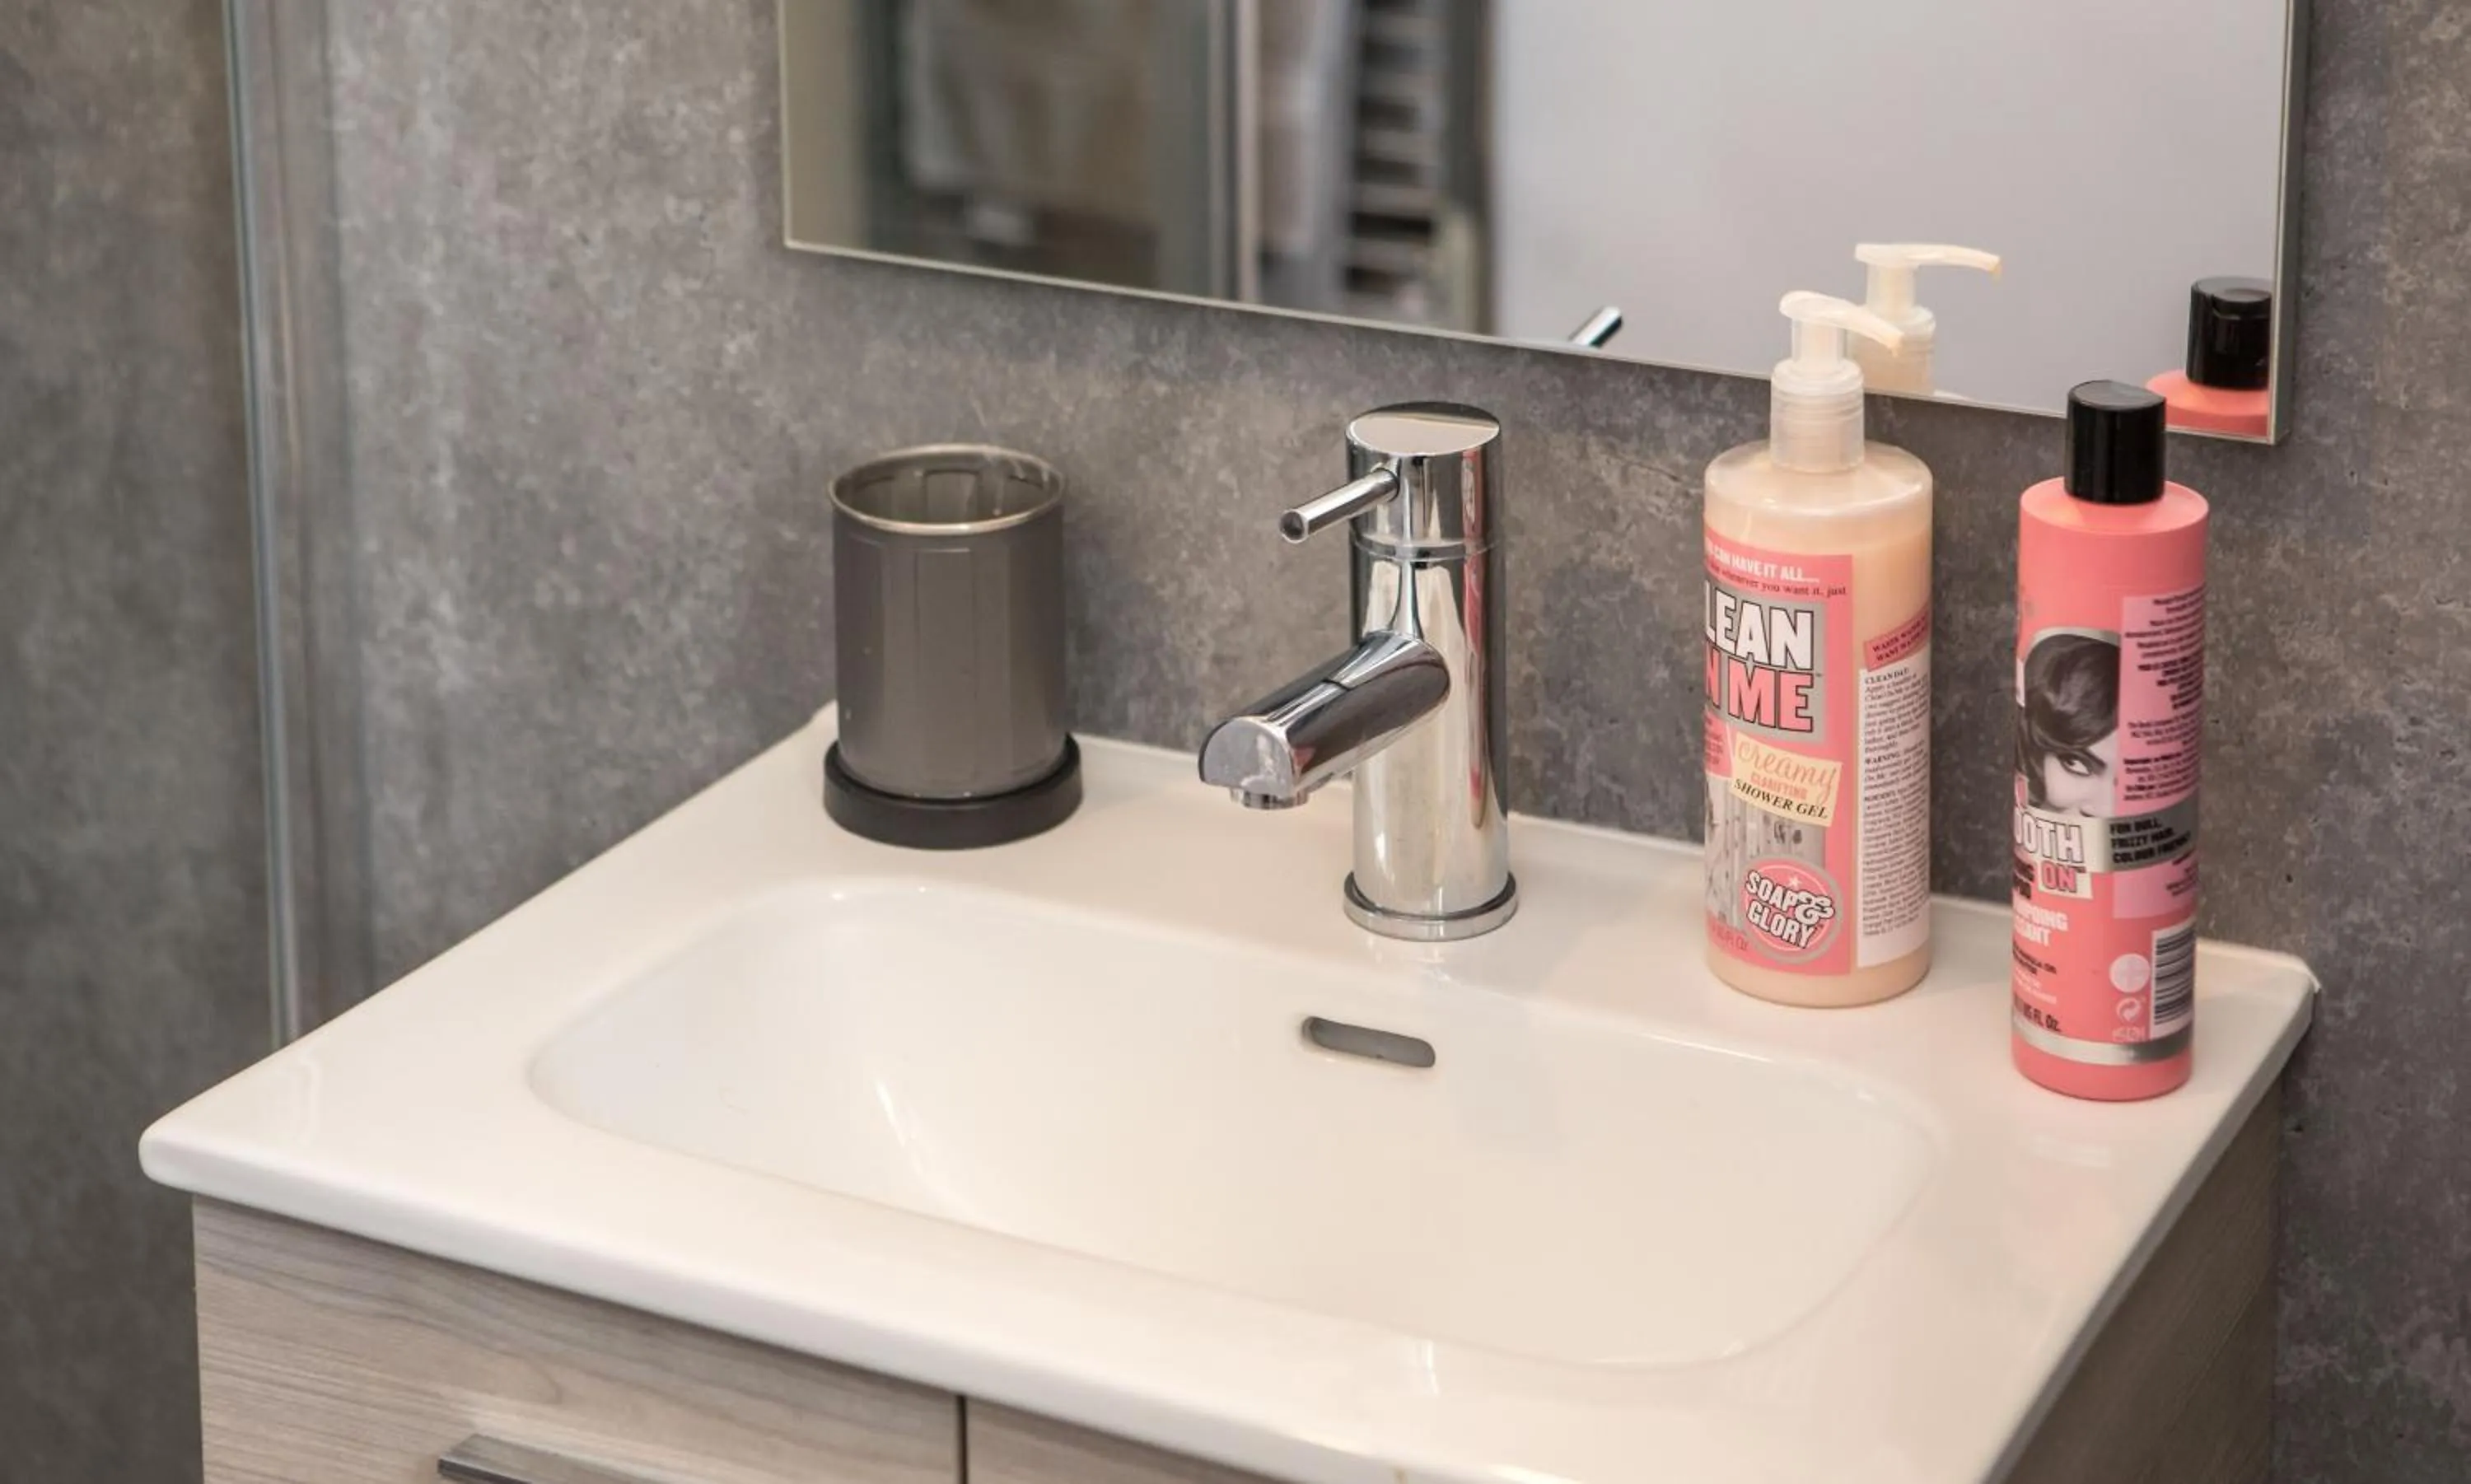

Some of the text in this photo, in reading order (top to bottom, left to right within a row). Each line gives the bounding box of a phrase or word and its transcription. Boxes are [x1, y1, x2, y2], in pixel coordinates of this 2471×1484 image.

[1731, 553, 1763, 576] HAVE
[1763, 563, 1777, 577] IT
[1762, 581, 1780, 592] you
[1783, 585, 1810, 595] want
[1826, 586, 1847, 598] just
[1727, 656, 1814, 733] ME
[1734, 778, 1829, 819] SHOWER GEL
[2041, 860, 2077, 893] ON
[1746, 898, 1817, 950] GLORY
